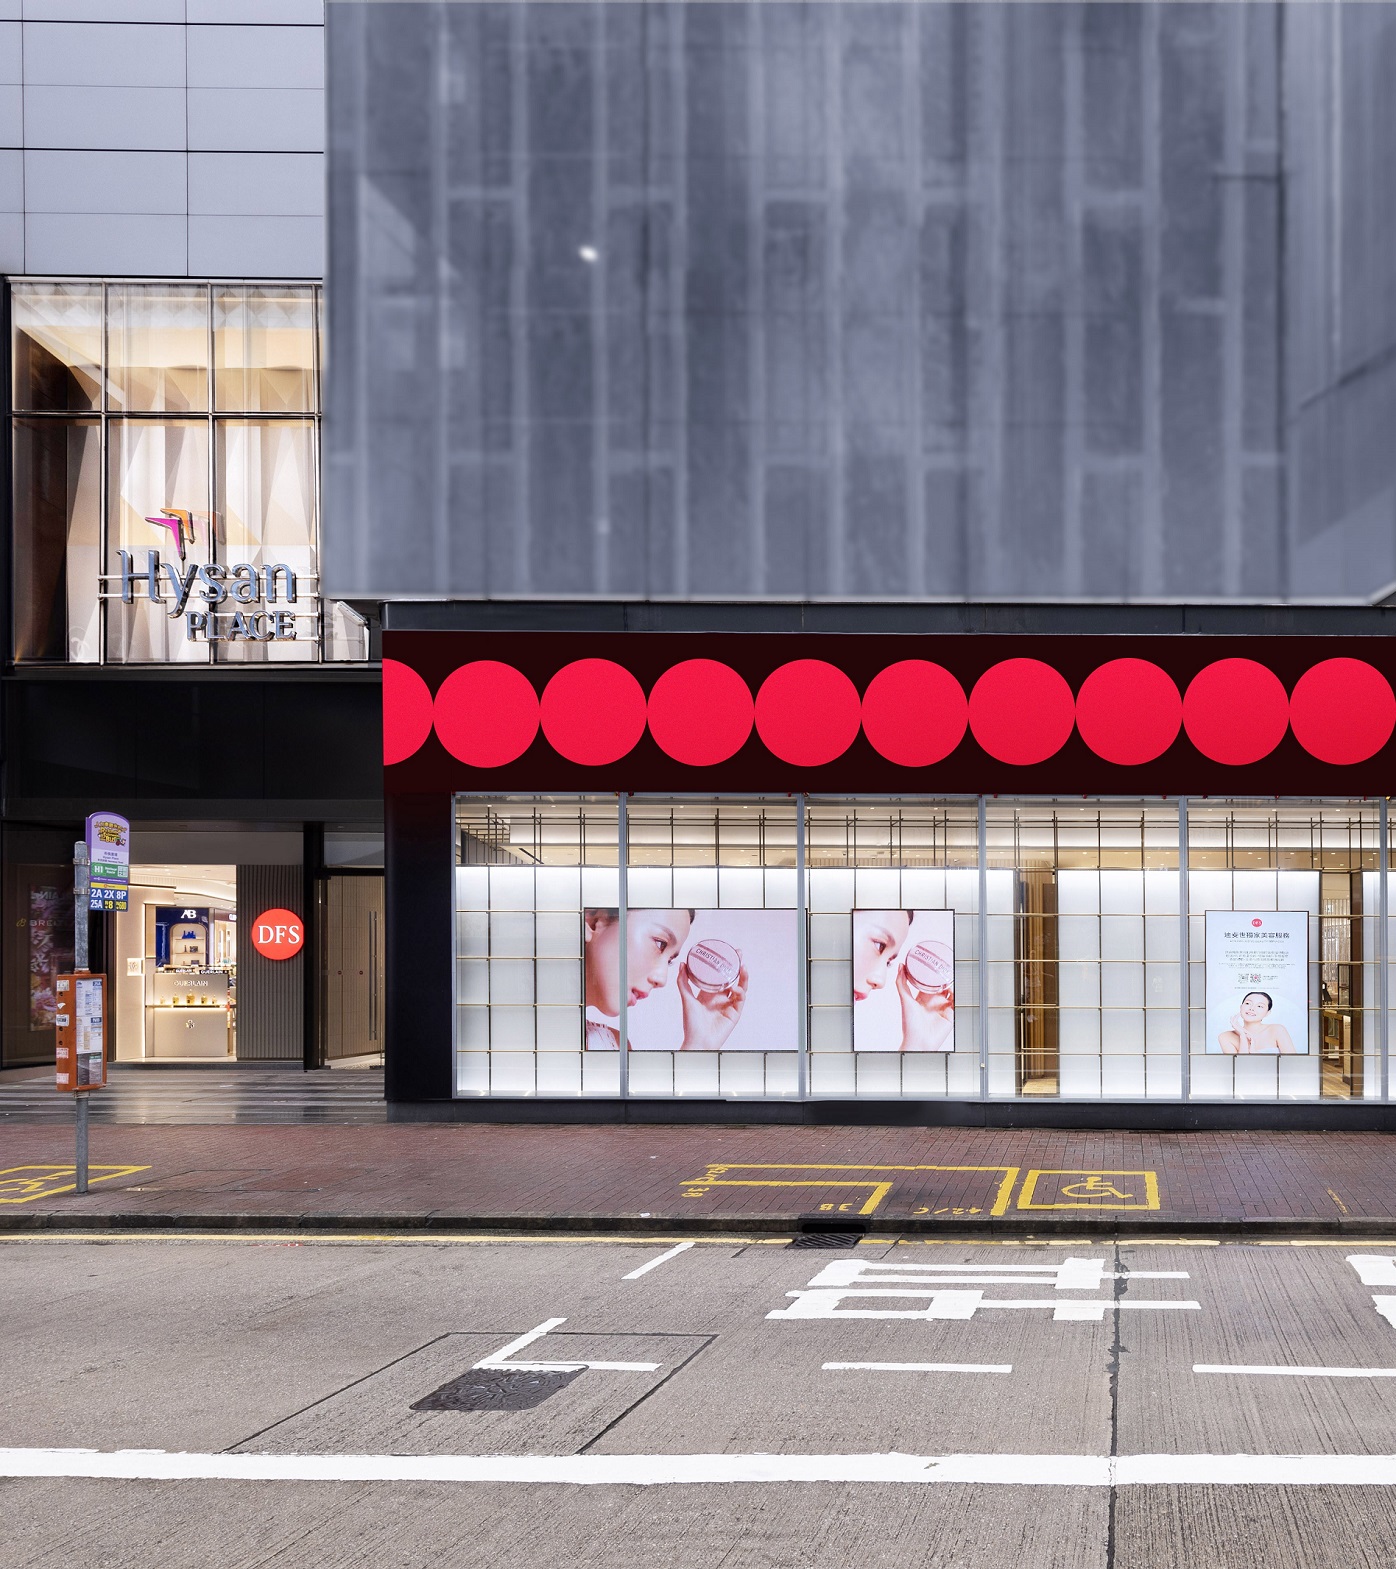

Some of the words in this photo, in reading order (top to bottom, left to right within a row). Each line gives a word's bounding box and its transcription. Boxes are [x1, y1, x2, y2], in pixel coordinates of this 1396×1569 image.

[116, 550, 297, 618] Hysan
[185, 610, 297, 641] PLACE
[94, 865, 104, 873] H1
[91, 889, 102, 898] 2A
[104, 890, 114, 899] 2X
[116, 890, 126, 899] 8P
[91, 899, 103, 909] 25A
[257, 925, 300, 944] DFS
[695, 948, 720, 965] CHRISTIAN
[914, 949, 939, 967] CHRISTIAN
[818, 1203, 852, 1211] 3B
